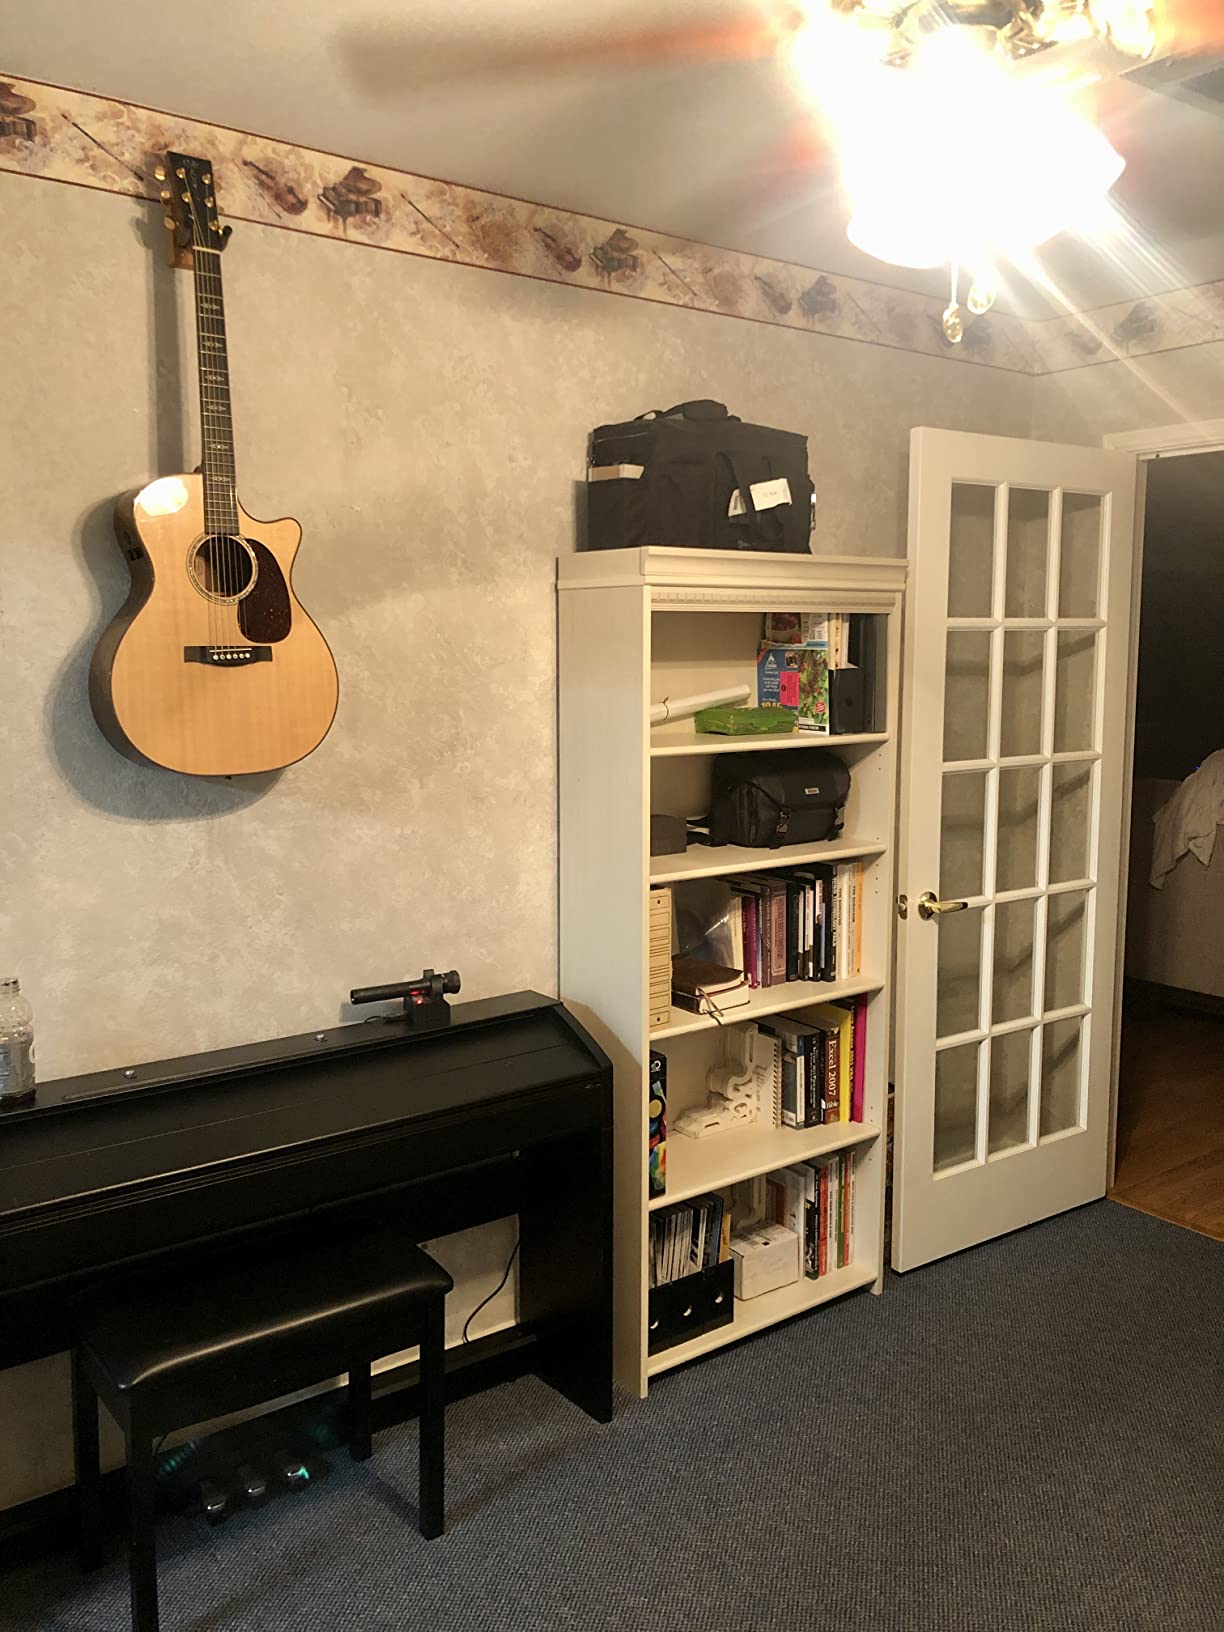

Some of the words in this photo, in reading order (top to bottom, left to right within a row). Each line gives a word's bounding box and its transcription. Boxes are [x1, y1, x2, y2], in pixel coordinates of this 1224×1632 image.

[828, 1040, 837, 1070] Excel
[828, 1071, 837, 1096] 2007
[826, 1099, 839, 1110] Bible
